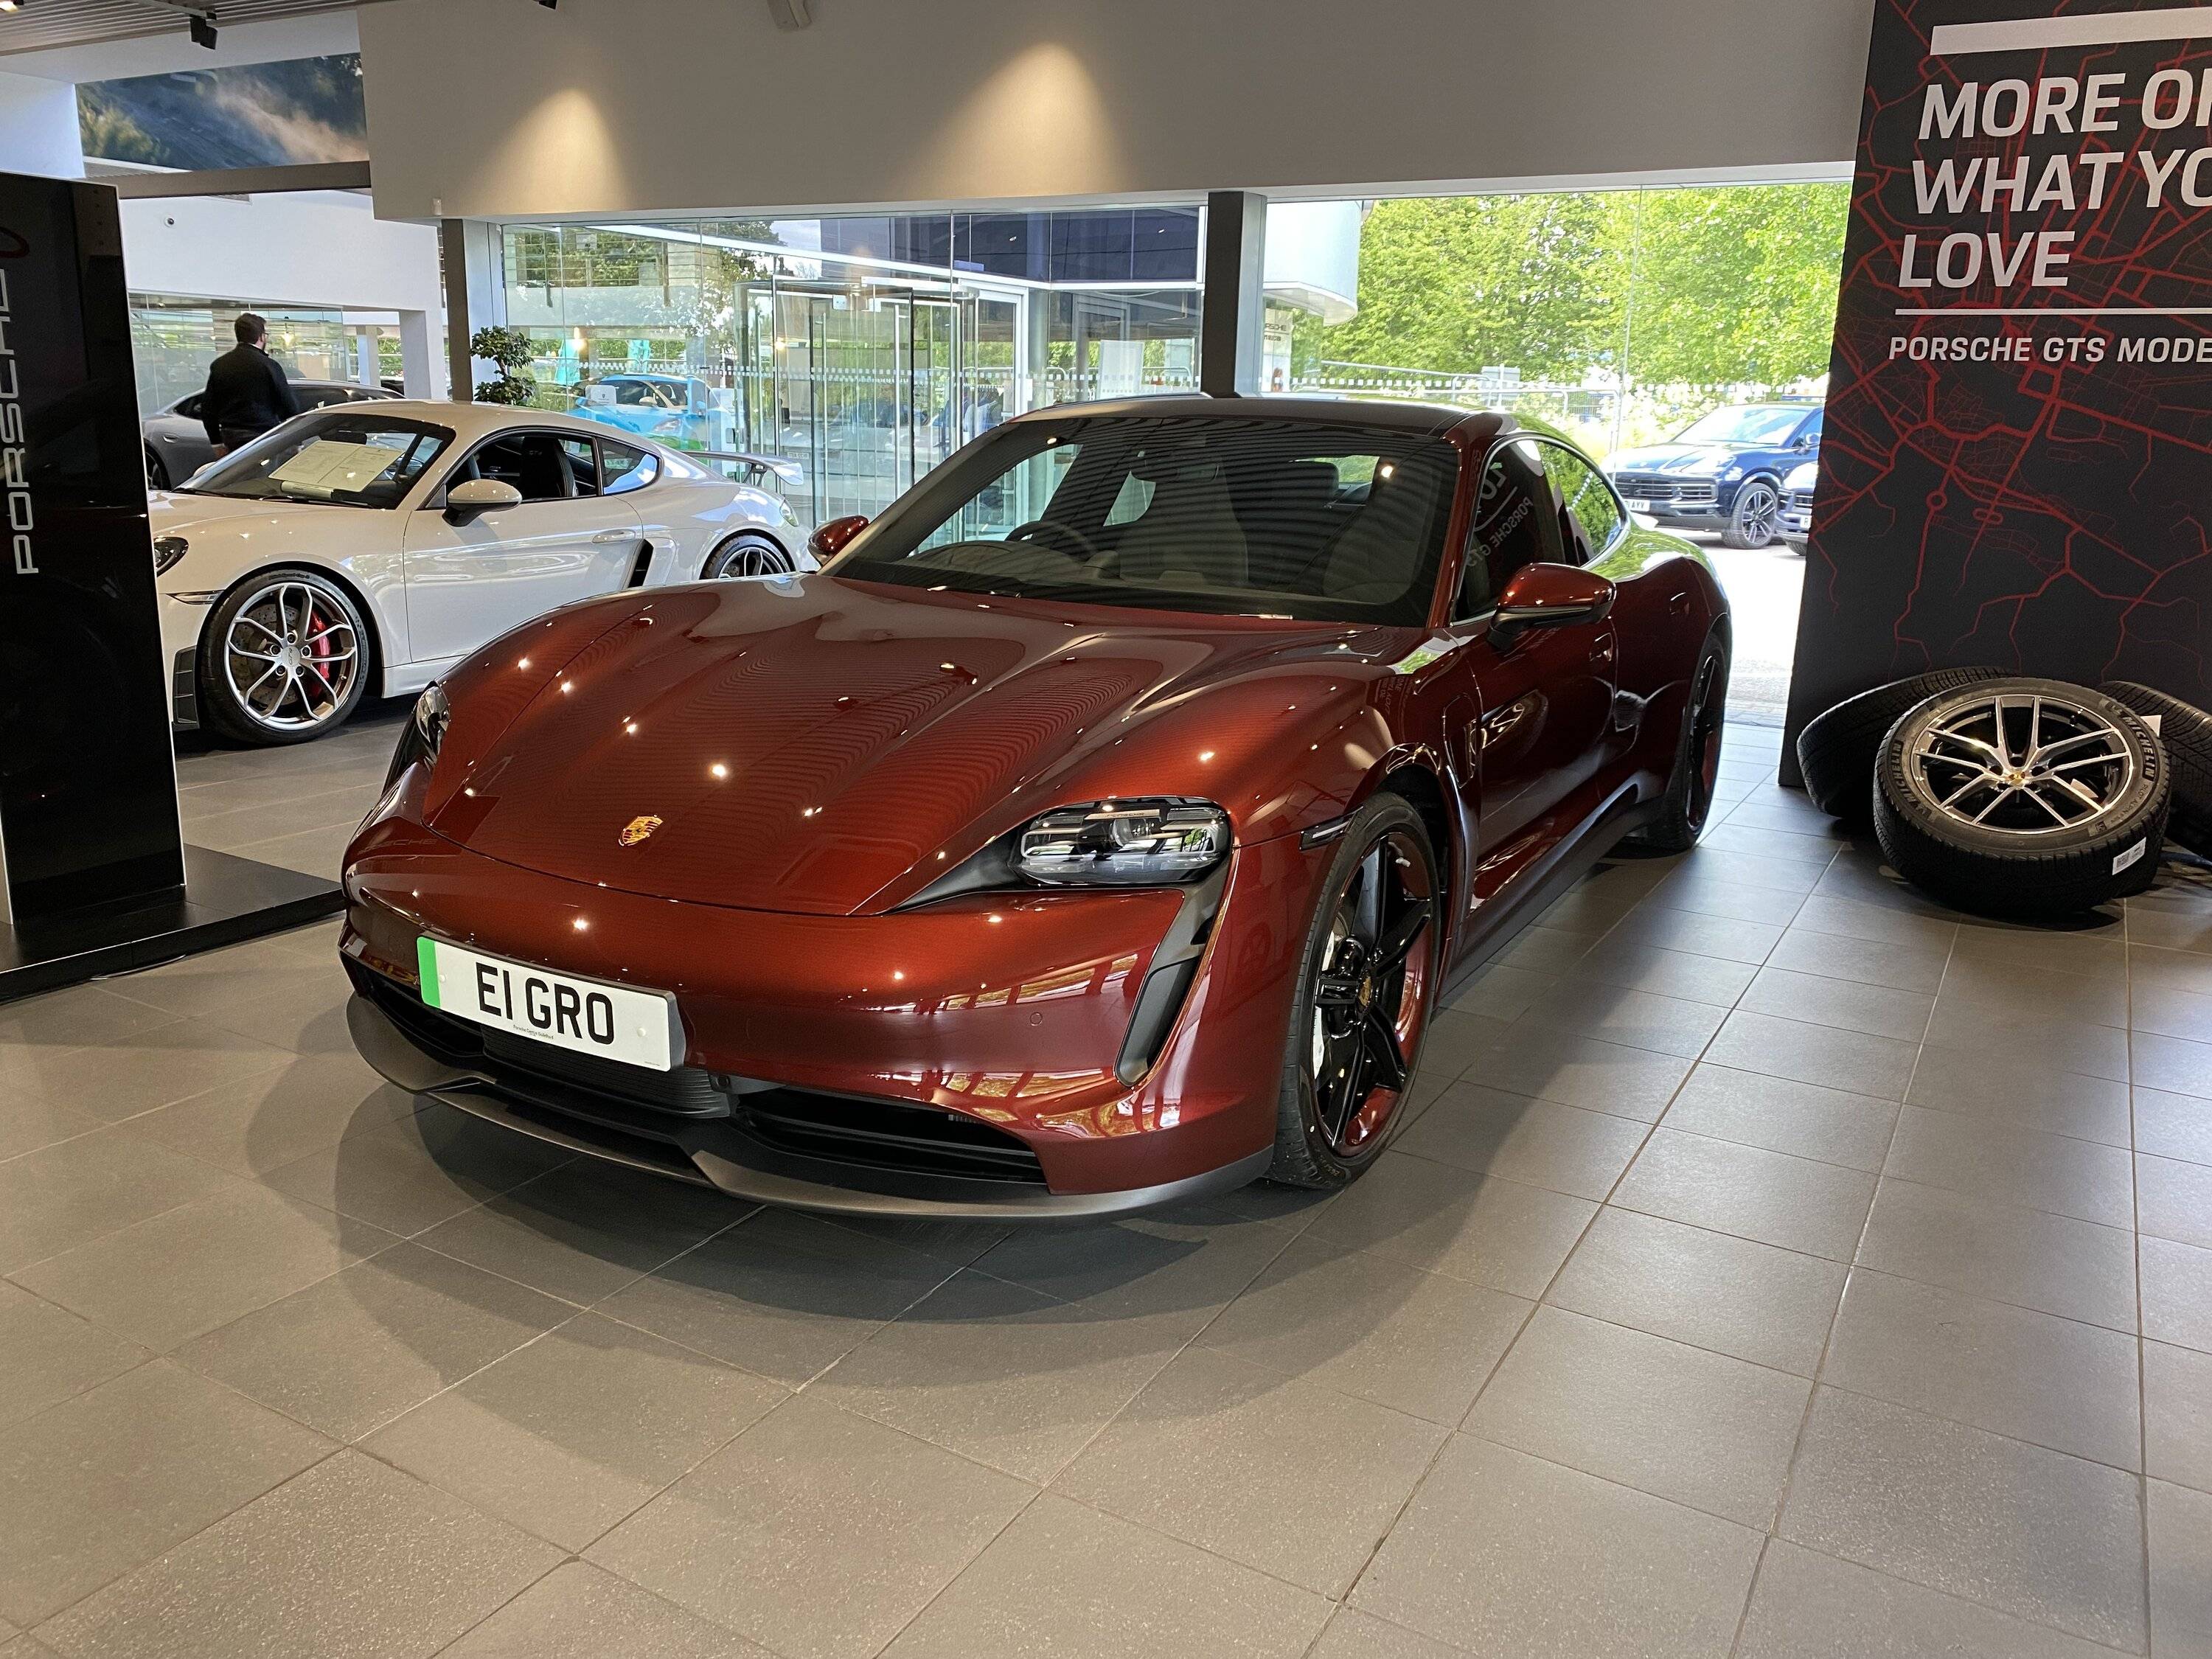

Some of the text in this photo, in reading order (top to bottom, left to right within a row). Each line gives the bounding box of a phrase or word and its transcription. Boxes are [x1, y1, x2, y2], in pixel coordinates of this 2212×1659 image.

[1919, 72, 2126, 139] MORE
[1912, 151, 2124, 214] WHAT
[1899, 231, 2076, 288] LOVE
[1888, 336, 2032, 361] PORSCHE
[2043, 337, 2106, 362] GTS
[1891, 743, 1917, 803] MICHELIN
[2123, 716, 2155, 778] MICHELIN
[525, 977, 614, 1045] GRO
